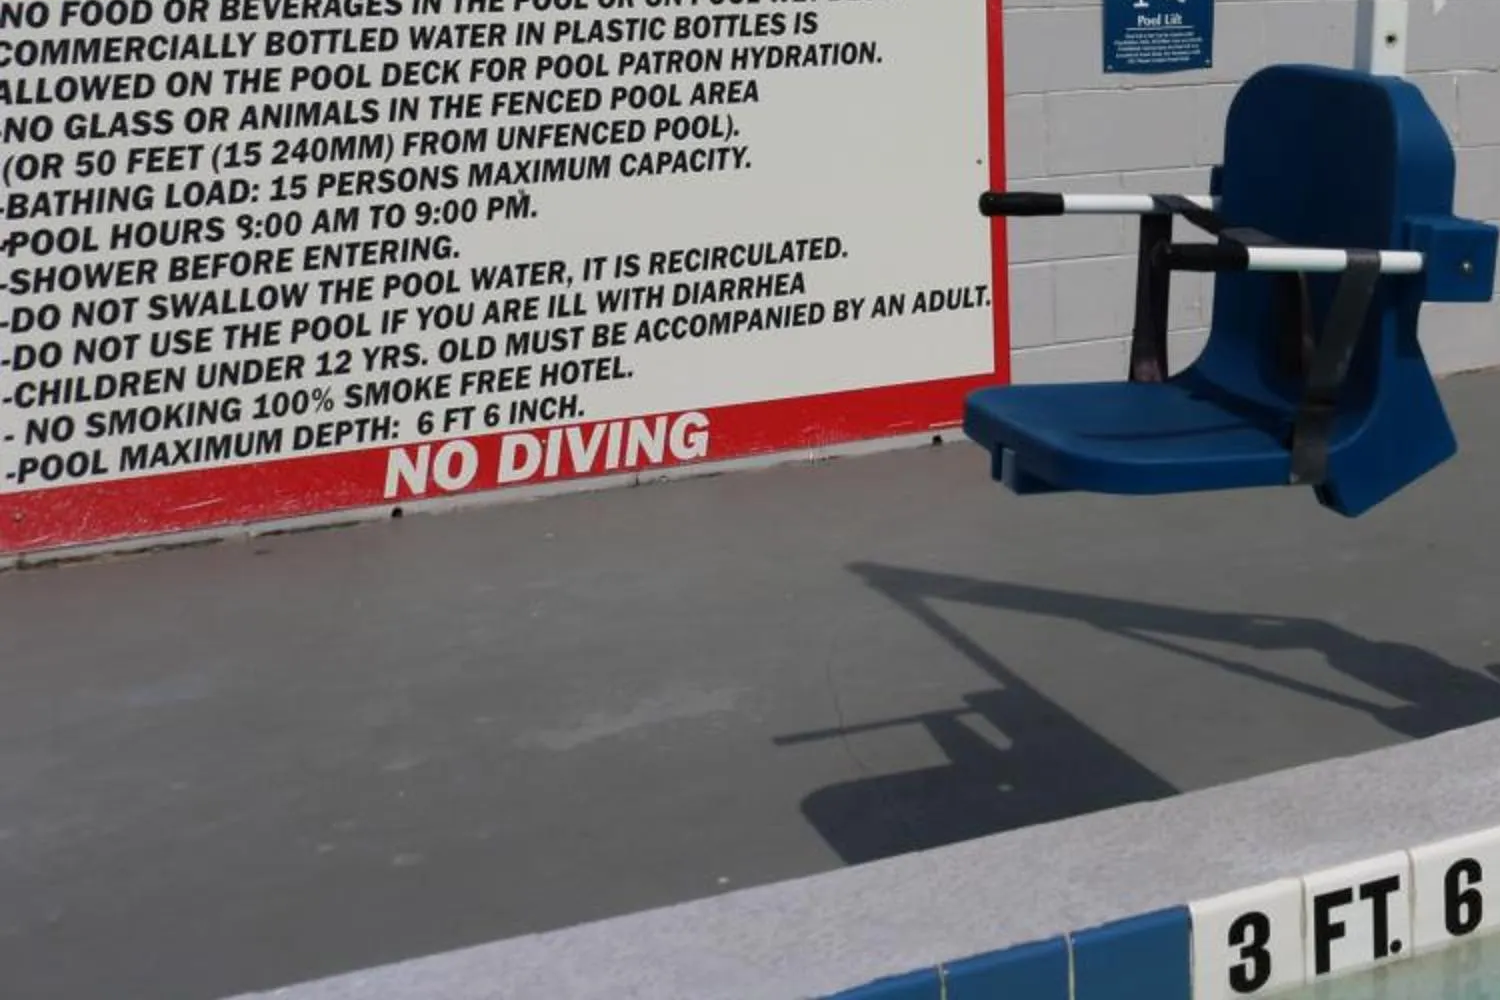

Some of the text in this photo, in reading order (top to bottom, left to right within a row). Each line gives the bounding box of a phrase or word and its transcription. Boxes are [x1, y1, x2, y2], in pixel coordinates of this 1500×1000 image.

[0, 0, 50, 29] NO
[0, 11, 818, 68] COMMERCIALLY BOTTLED WATER IN PLASTIC BOTTLES IS
[1137, 12, 1161, 26] Pool
[0, 41, 883, 106] ALLOWED ON THE POOL DECK FOR POOL PATRON HYDRATION.
[0, 79, 759, 144] NO GLASS OR ANIMALS IN THE FENCED POOL AREA
[2, 114, 740, 188] (OR 50 FEET (15 240MM) FROM UNFENCED POOL).
[164, 178, 260, 209] LOAD:
[269, 174, 308, 202] 15
[317, 164, 459, 199] PERSONS
[467, 154, 612, 188] MAXIMUM
[619, 145, 751, 178] CAPACITY.
[109, 216, 225, 251] HOURS
[310, 206, 360, 235] AM
[369, 203, 406, 230] TO
[415, 197, 478, 227] 9:00
[486, 189, 537, 221] PM.
[0, 236, 848, 334] -DO NOT SWALLOW THE POOL WATER, IT IS RECIRCULATED.
[168, 247, 295, 283] BEFORE
[302, 234, 460, 271] ENTERING.
[0, 271, 805, 372] -DO NOT USE THE POOL IF YOU ARE ILL WITH DIARRHEA
[2, 284, 991, 409] -CHILDREN UNDER 12 YRS. OLD MUST BE ACCOMPANIED BY AN ADULT.
[25, 415, 75, 446] NO
[85, 396, 242, 439] SMOKING
[252, 387, 335, 420] 100%
[343, 373, 452, 409] SMOKE
[459, 365, 533, 397] FREE
[539, 355, 633, 388] HOTEL.
[5, 394, 585, 485] -POOL MAXIMUM DEPTH: 6 FT 6 INCH.
[383, 411, 711, 499] NO DIVING
[1227, 911, 1271, 994] 3
[1313, 875, 1403, 975] FT.
[1443, 857, 1483, 937] 6
